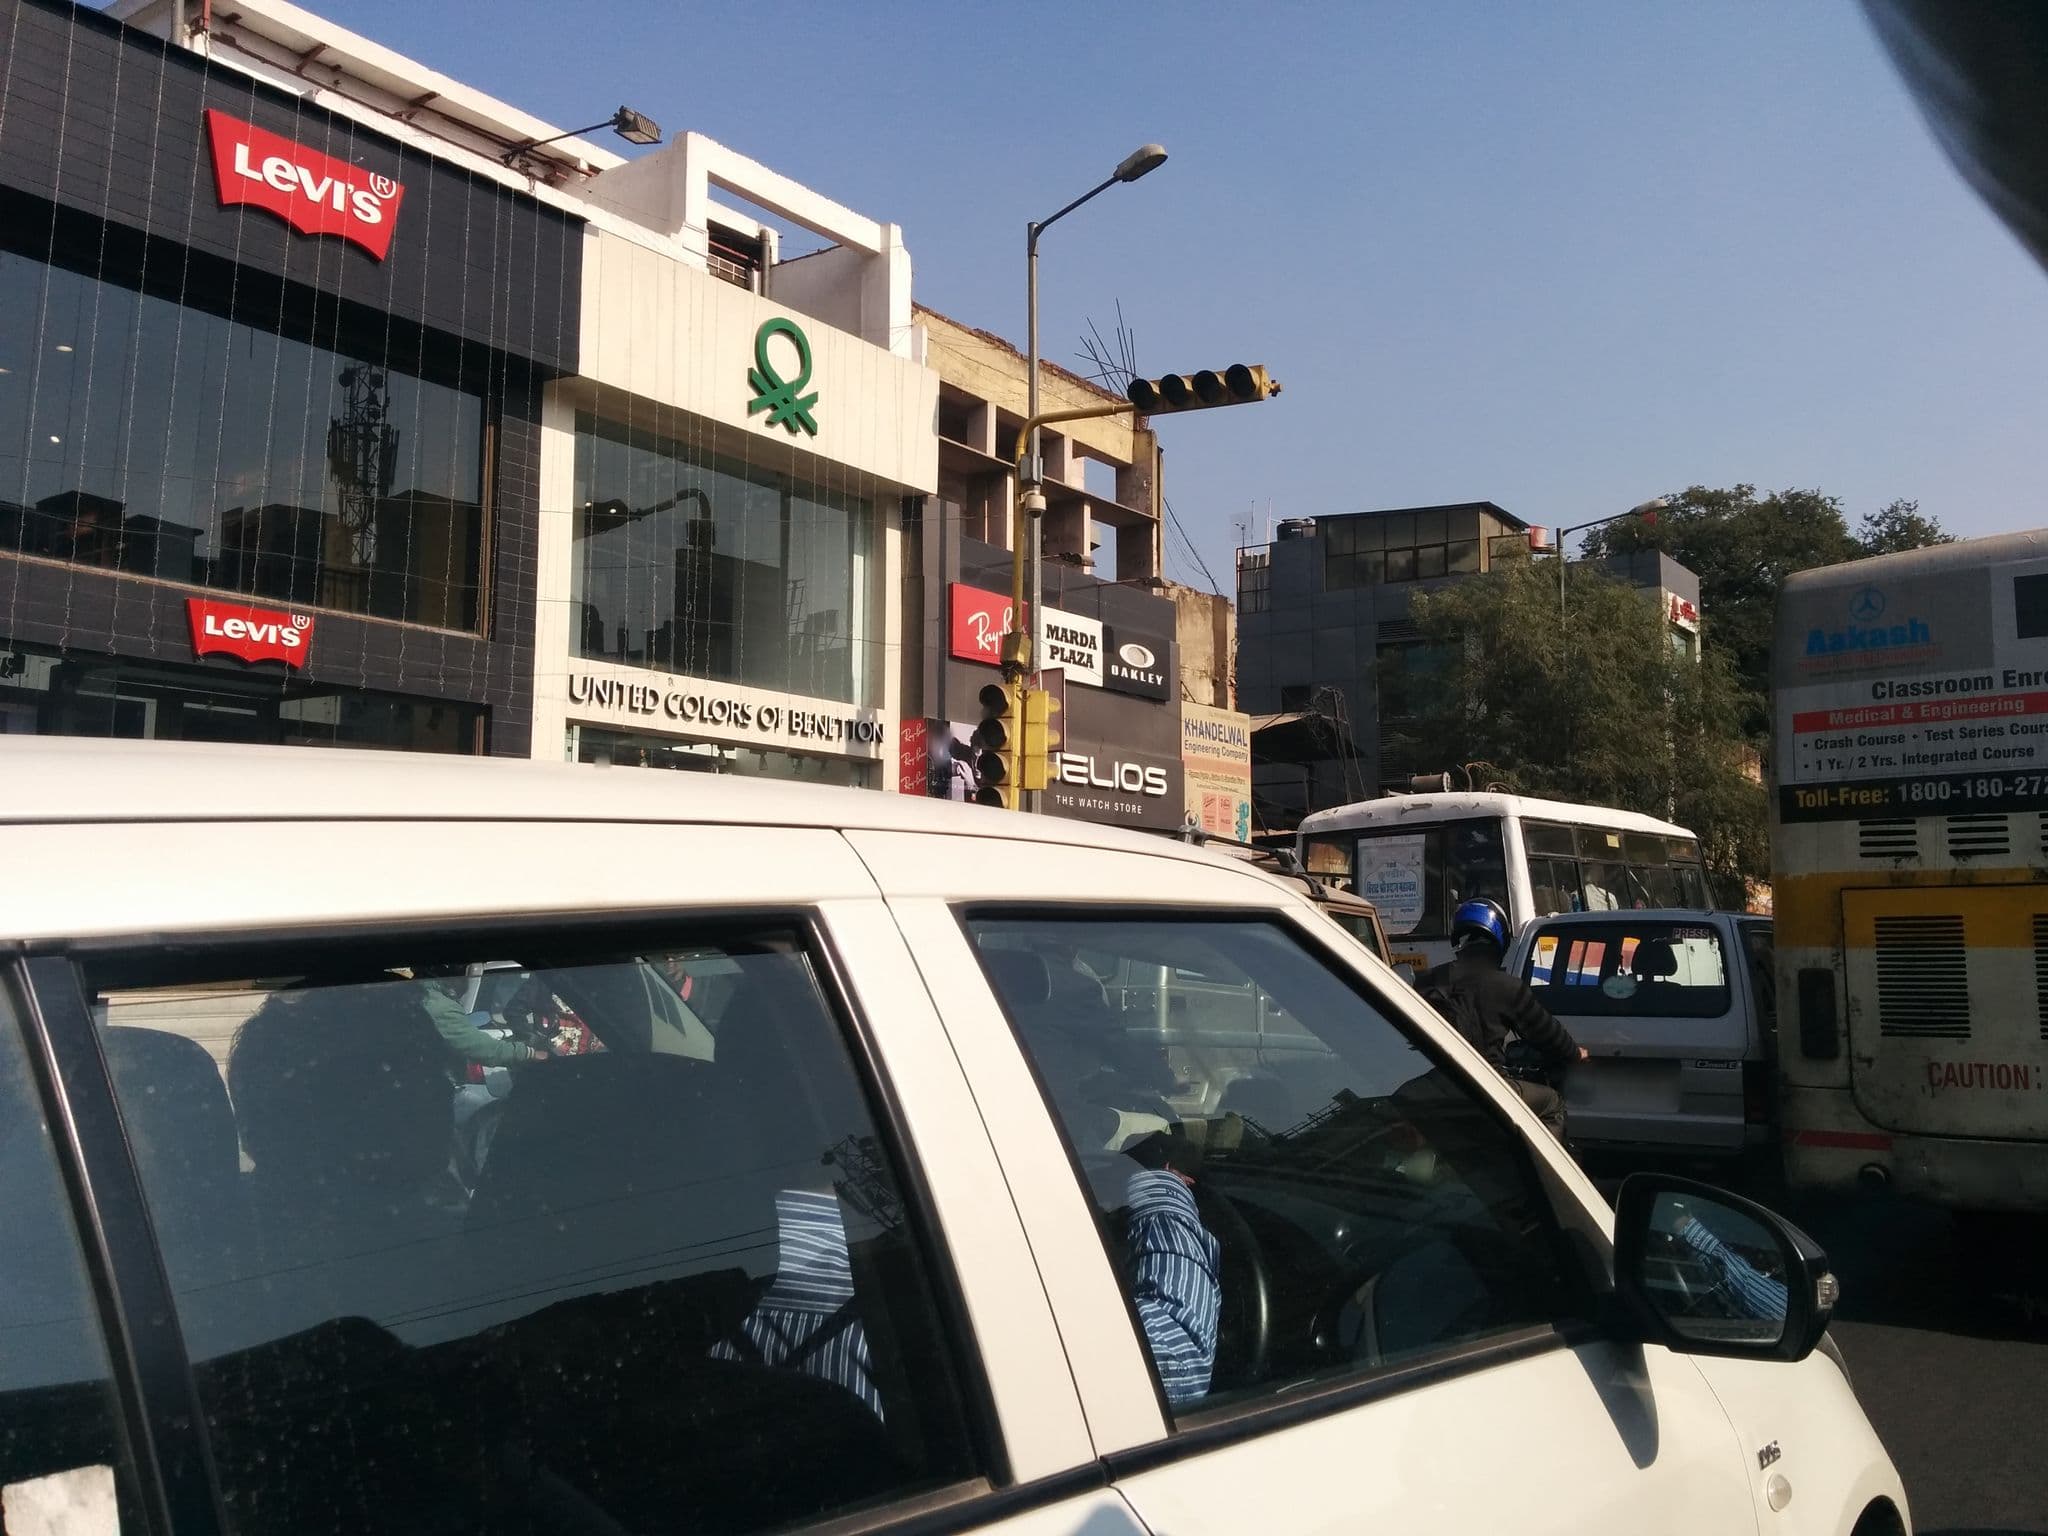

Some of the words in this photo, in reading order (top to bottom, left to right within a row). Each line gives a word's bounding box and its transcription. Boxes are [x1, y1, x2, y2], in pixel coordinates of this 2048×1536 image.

[1046, 624, 1097, 650] MARDA
[1806, 617, 1930, 656] Aakash
[1049, 645, 1095, 669] PLAZA
[1111, 664, 1164, 686] OAKLEY
[1872, 673, 1994, 700] Classroom
[2002, 669, 2048, 689] Enr
[569, 674, 660, 714] UNITED
[663, 691, 753, 728] COLORS
[756, 704, 786, 732] OF
[788, 708, 885, 744] BENETTON
[1829, 706, 1895, 726] Medical
[1902, 705, 1914, 720] &
[1920, 698, 2025, 719] Engineering
[1184, 718, 1248, 747] KHANDELWAL
[1814, 735, 1853, 750] Crash
[1857, 732, 1906, 747] Course
[1925, 728, 1955, 743] Test
[1959, 724, 2004, 739] Series
[1184, 740, 1220, 757] Engineering
[1221, 746, 1249, 763] Company
[1816, 760, 1822, 771] 1
[1827, 758, 1845, 771] Yr.
[1858, 756, 1867, 769] 2
[1871, 755, 1897, 768] Yrs.
[1902, 747, 1978, 766] Integrated
[1983, 745, 2035, 760] Course
[1056, 794, 1075, 806] THE
[1078, 798, 1110, 811] WATCH
[1114, 802, 1143, 815] STORE
[1795, 786, 1890, 808] Toll-Free:
[1673, 928, 1710, 939] PRESS
[1928, 1061, 2030, 1090] CAUTION
